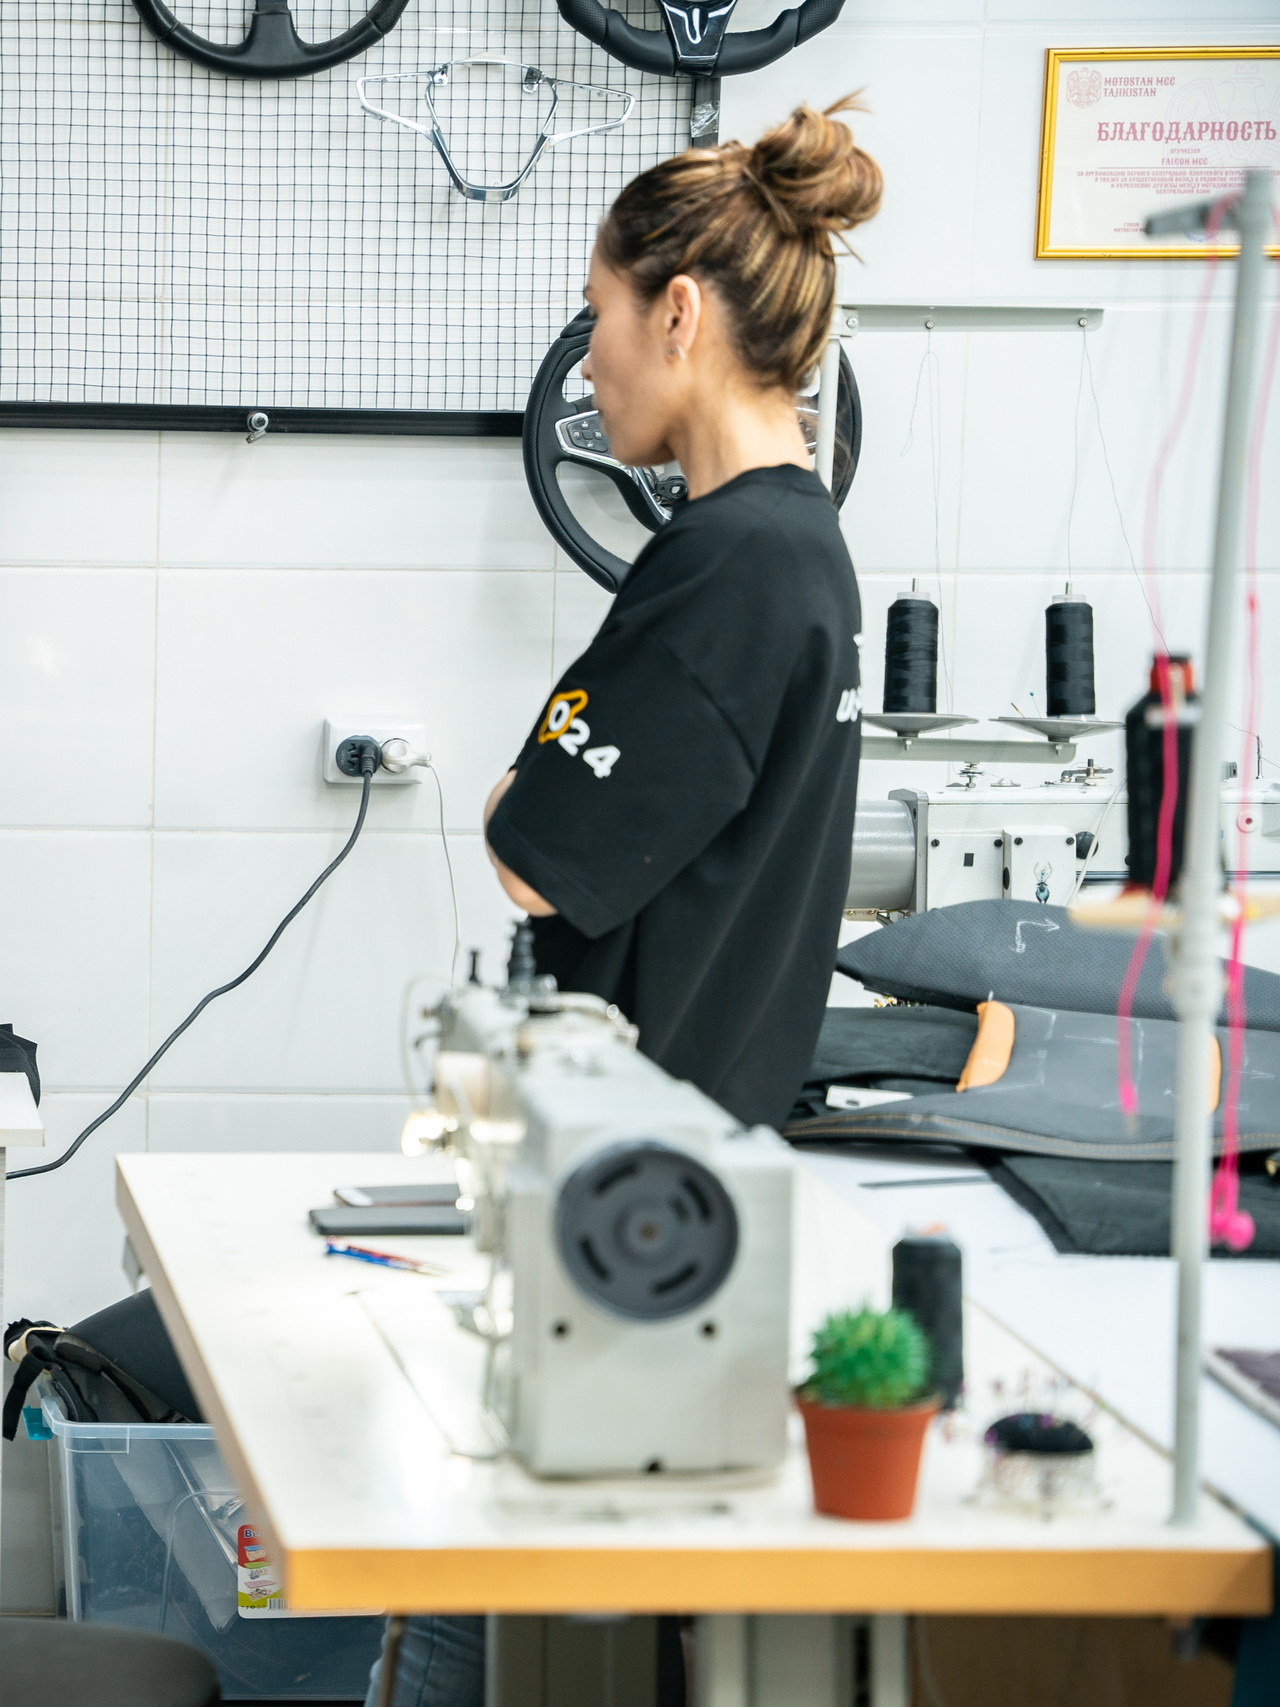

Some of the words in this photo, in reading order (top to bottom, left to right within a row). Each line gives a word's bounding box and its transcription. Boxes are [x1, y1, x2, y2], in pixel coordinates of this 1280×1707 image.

[1104, 77, 1153, 86] MOTOSTAN
[1104, 88, 1156, 97] TAJIKISTAN
[1097, 121, 1277, 144] БЛАГОДАРНОСТЬ
[1161, 157, 1190, 166] FALCON
[548, 699, 621, 779] 024
